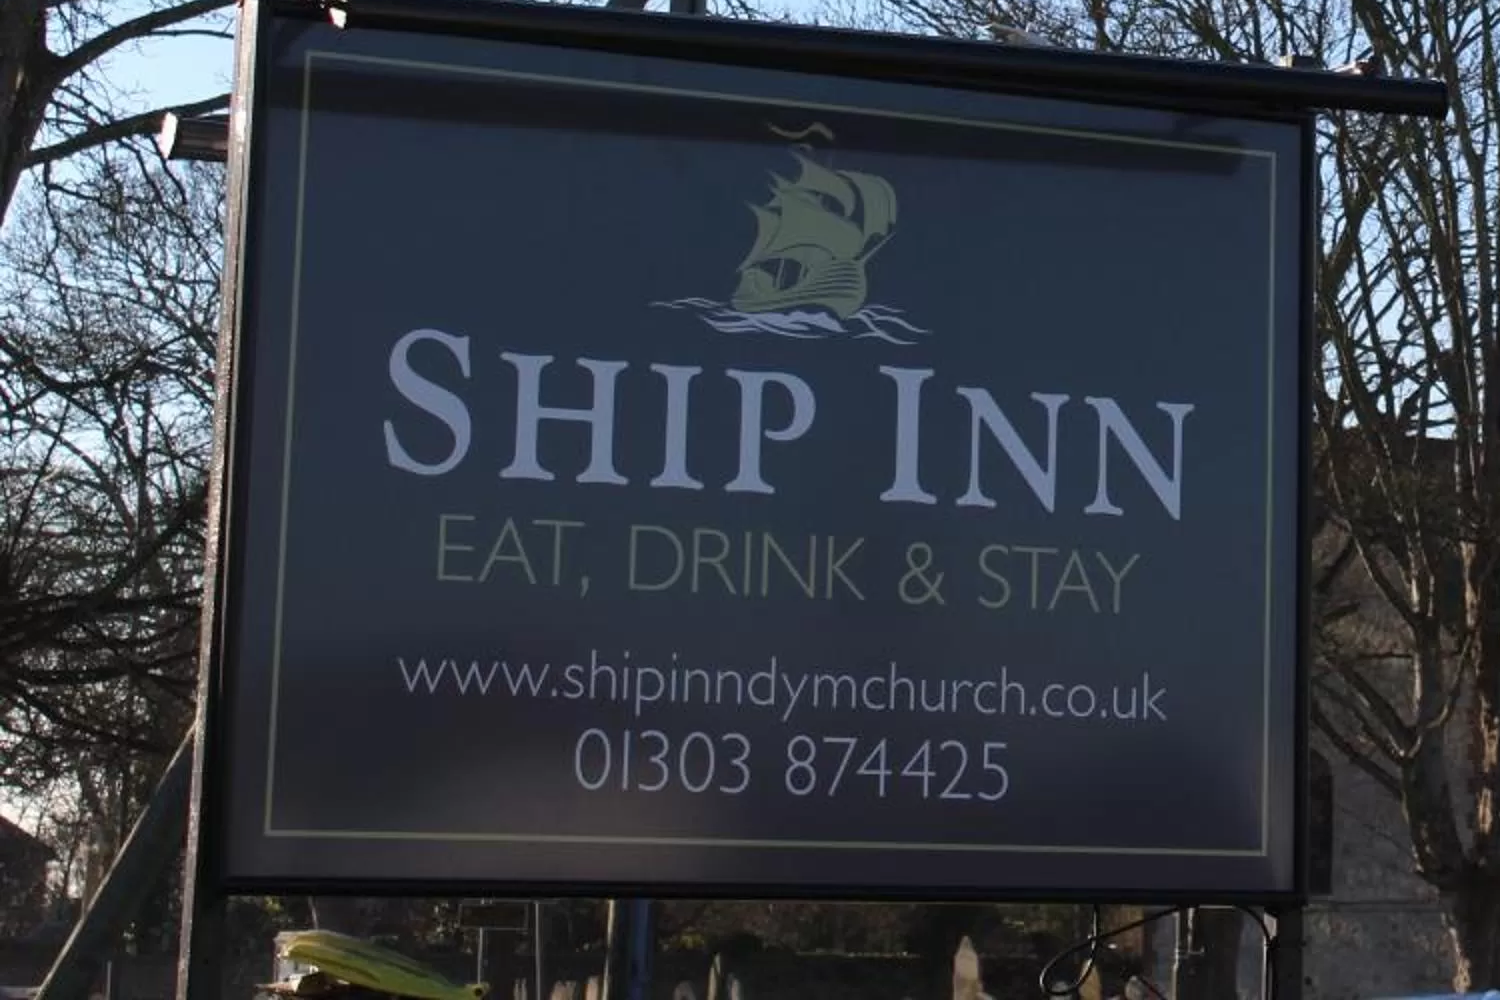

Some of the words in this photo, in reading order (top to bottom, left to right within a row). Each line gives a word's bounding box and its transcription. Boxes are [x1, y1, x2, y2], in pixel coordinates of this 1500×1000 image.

[382, 327, 817, 495] SHIP
[878, 364, 1196, 521] INN
[436, 513, 590, 597] EAT,
[629, 525, 866, 601] DRINK
[899, 541, 946, 605] &
[977, 543, 1141, 615] STAY
[397, 648, 1168, 723] www.shipinndymchurch.co.uk
[574, 728, 751, 795] 01303
[785, 733, 1010, 802] 874425
